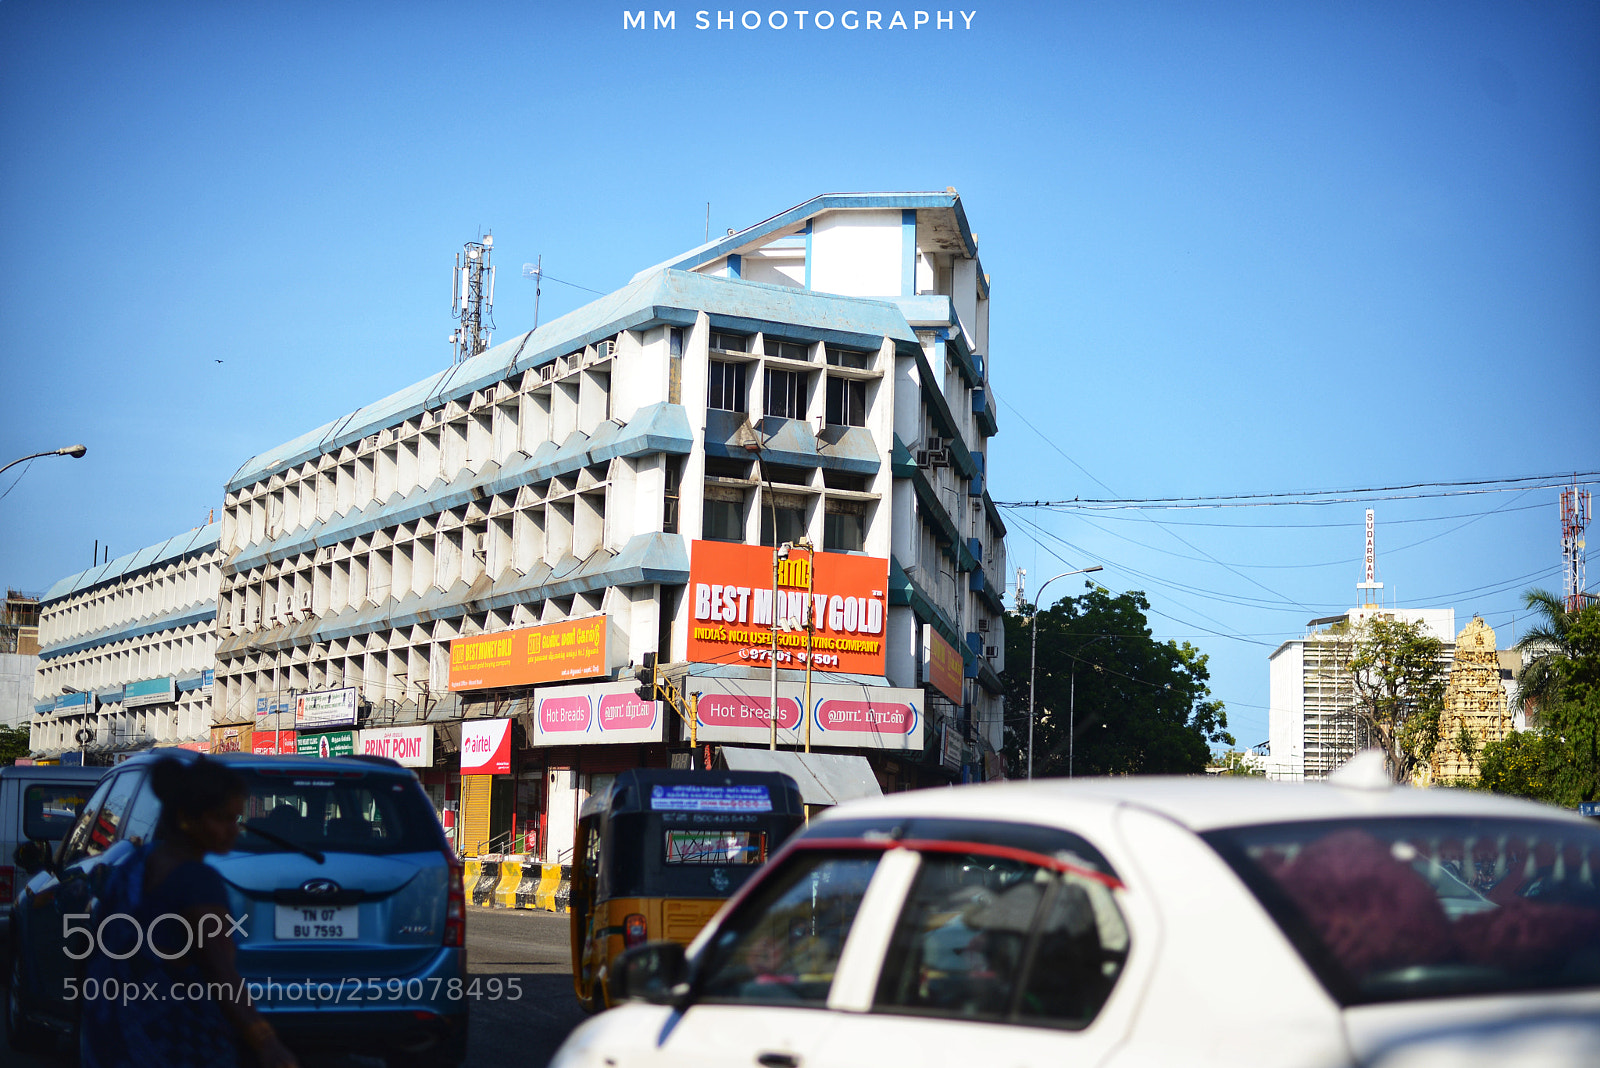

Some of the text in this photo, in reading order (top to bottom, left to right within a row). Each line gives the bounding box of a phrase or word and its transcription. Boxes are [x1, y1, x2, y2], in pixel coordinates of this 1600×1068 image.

[695, 583, 751, 623] BEST
[829, 595, 883, 634] GOLD
[694, 626, 726, 641] INDIA'S
[729, 630, 749, 643] NO1
[777, 634, 800, 647] GOLD
[835, 639, 879, 653] COMPANY
[465, 642, 479, 661] BEST
[479, 640, 497, 660] MONEY
[498, 638, 513, 658] GOLD
[546, 706, 585, 723] Hot Breads
[605, 704, 624, 721] ஹாட்
[710, 703, 735, 717] Hot
[828, 708, 862, 724] ஹாட்
[365, 737, 422, 758] PRINT POINT
[471, 734, 491, 753] airtel
[302, 909, 335, 922] TN 07
[294, 925, 343, 938] BU 7593
